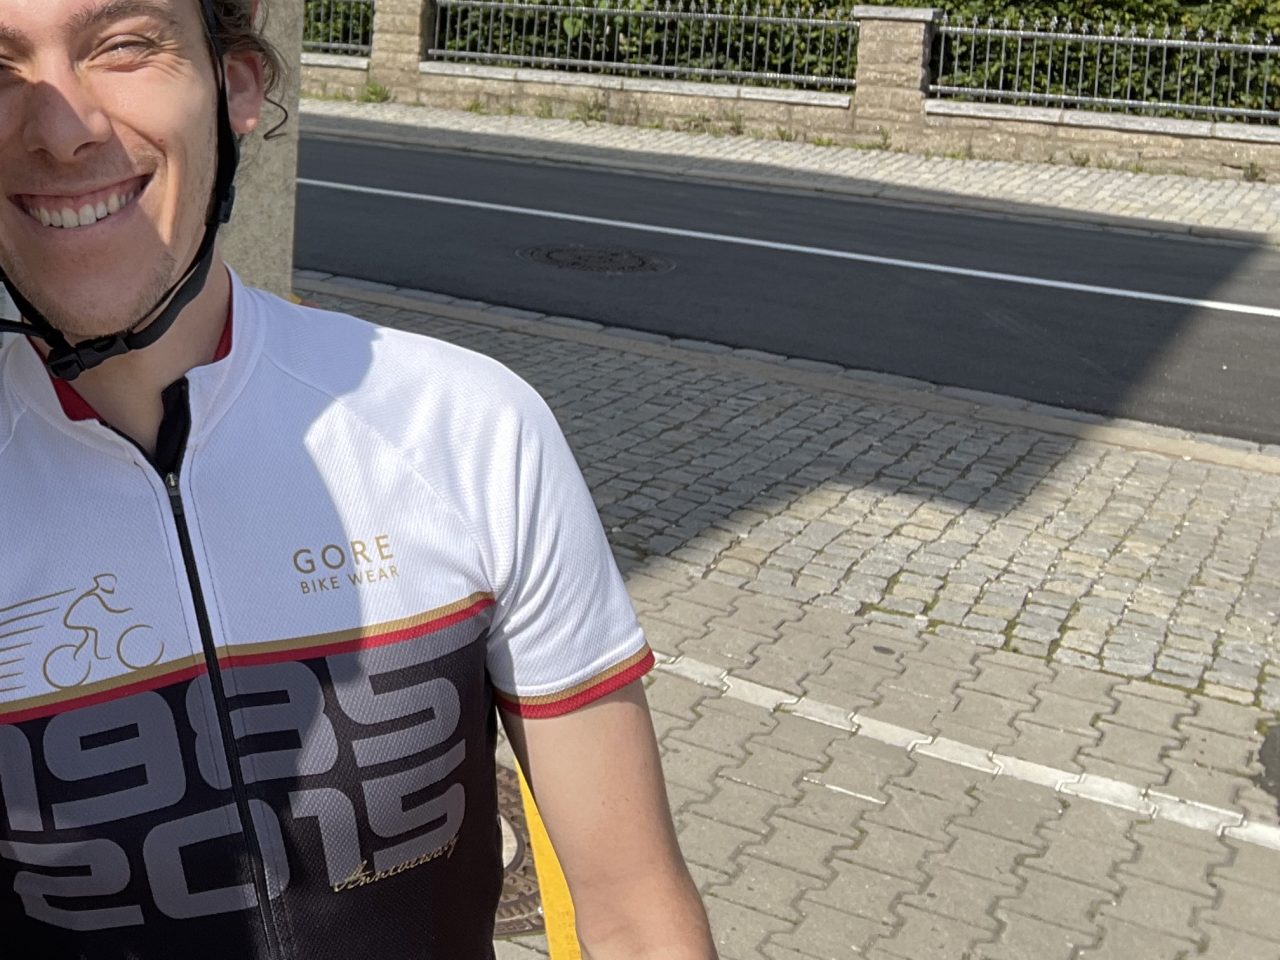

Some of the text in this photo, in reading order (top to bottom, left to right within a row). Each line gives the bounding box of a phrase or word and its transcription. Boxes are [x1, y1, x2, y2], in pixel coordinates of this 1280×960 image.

[293, 534, 394, 574] GORE
[300, 565, 400, 594] BIKE WEAR
